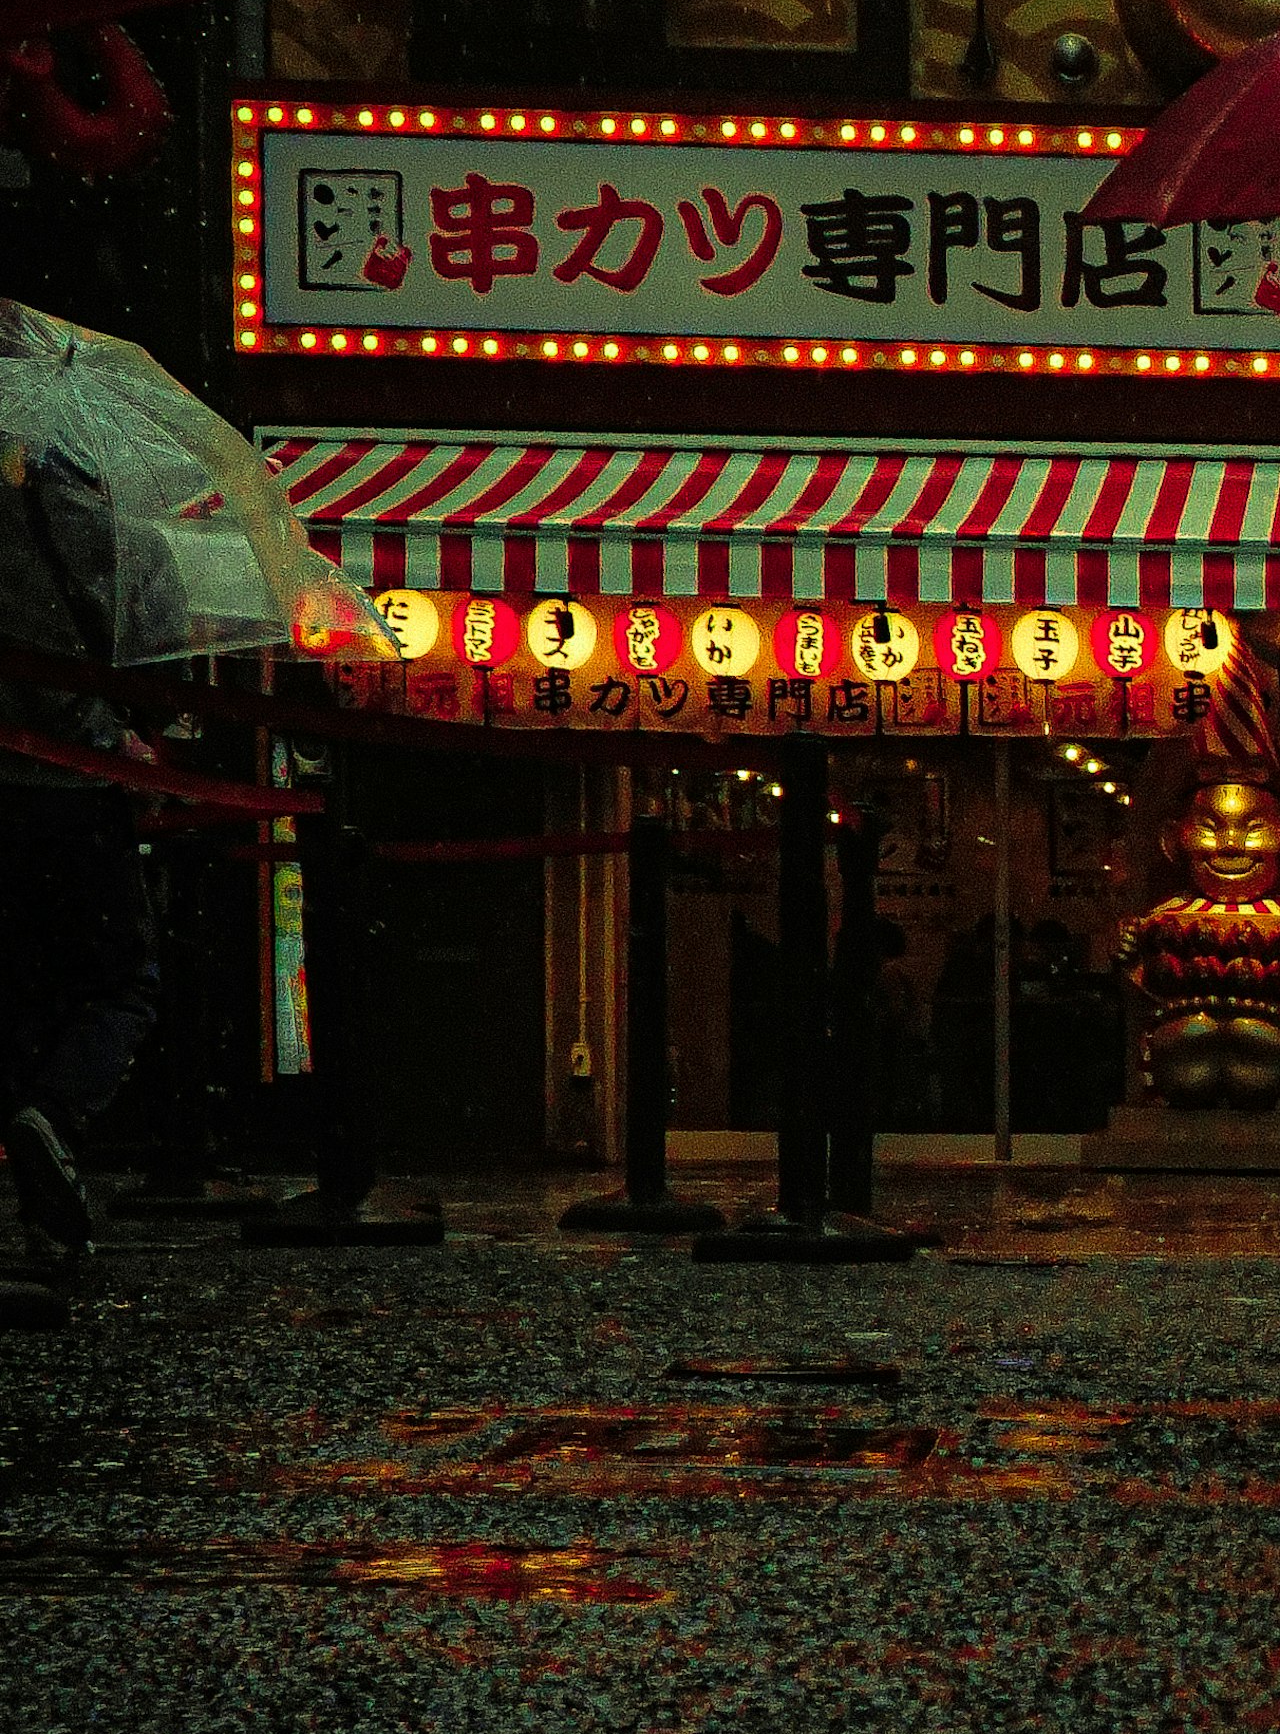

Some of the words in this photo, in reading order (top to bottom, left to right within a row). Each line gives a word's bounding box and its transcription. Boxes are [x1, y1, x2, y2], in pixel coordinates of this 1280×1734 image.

[429, 171, 1169, 313] 串カツ専門店
[706, 613, 733, 664] いか
[955, 617, 982, 673] 玉ねぎ
[1033, 618, 1060, 671] 玉子
[1113, 616, 1140, 669] 山芋
